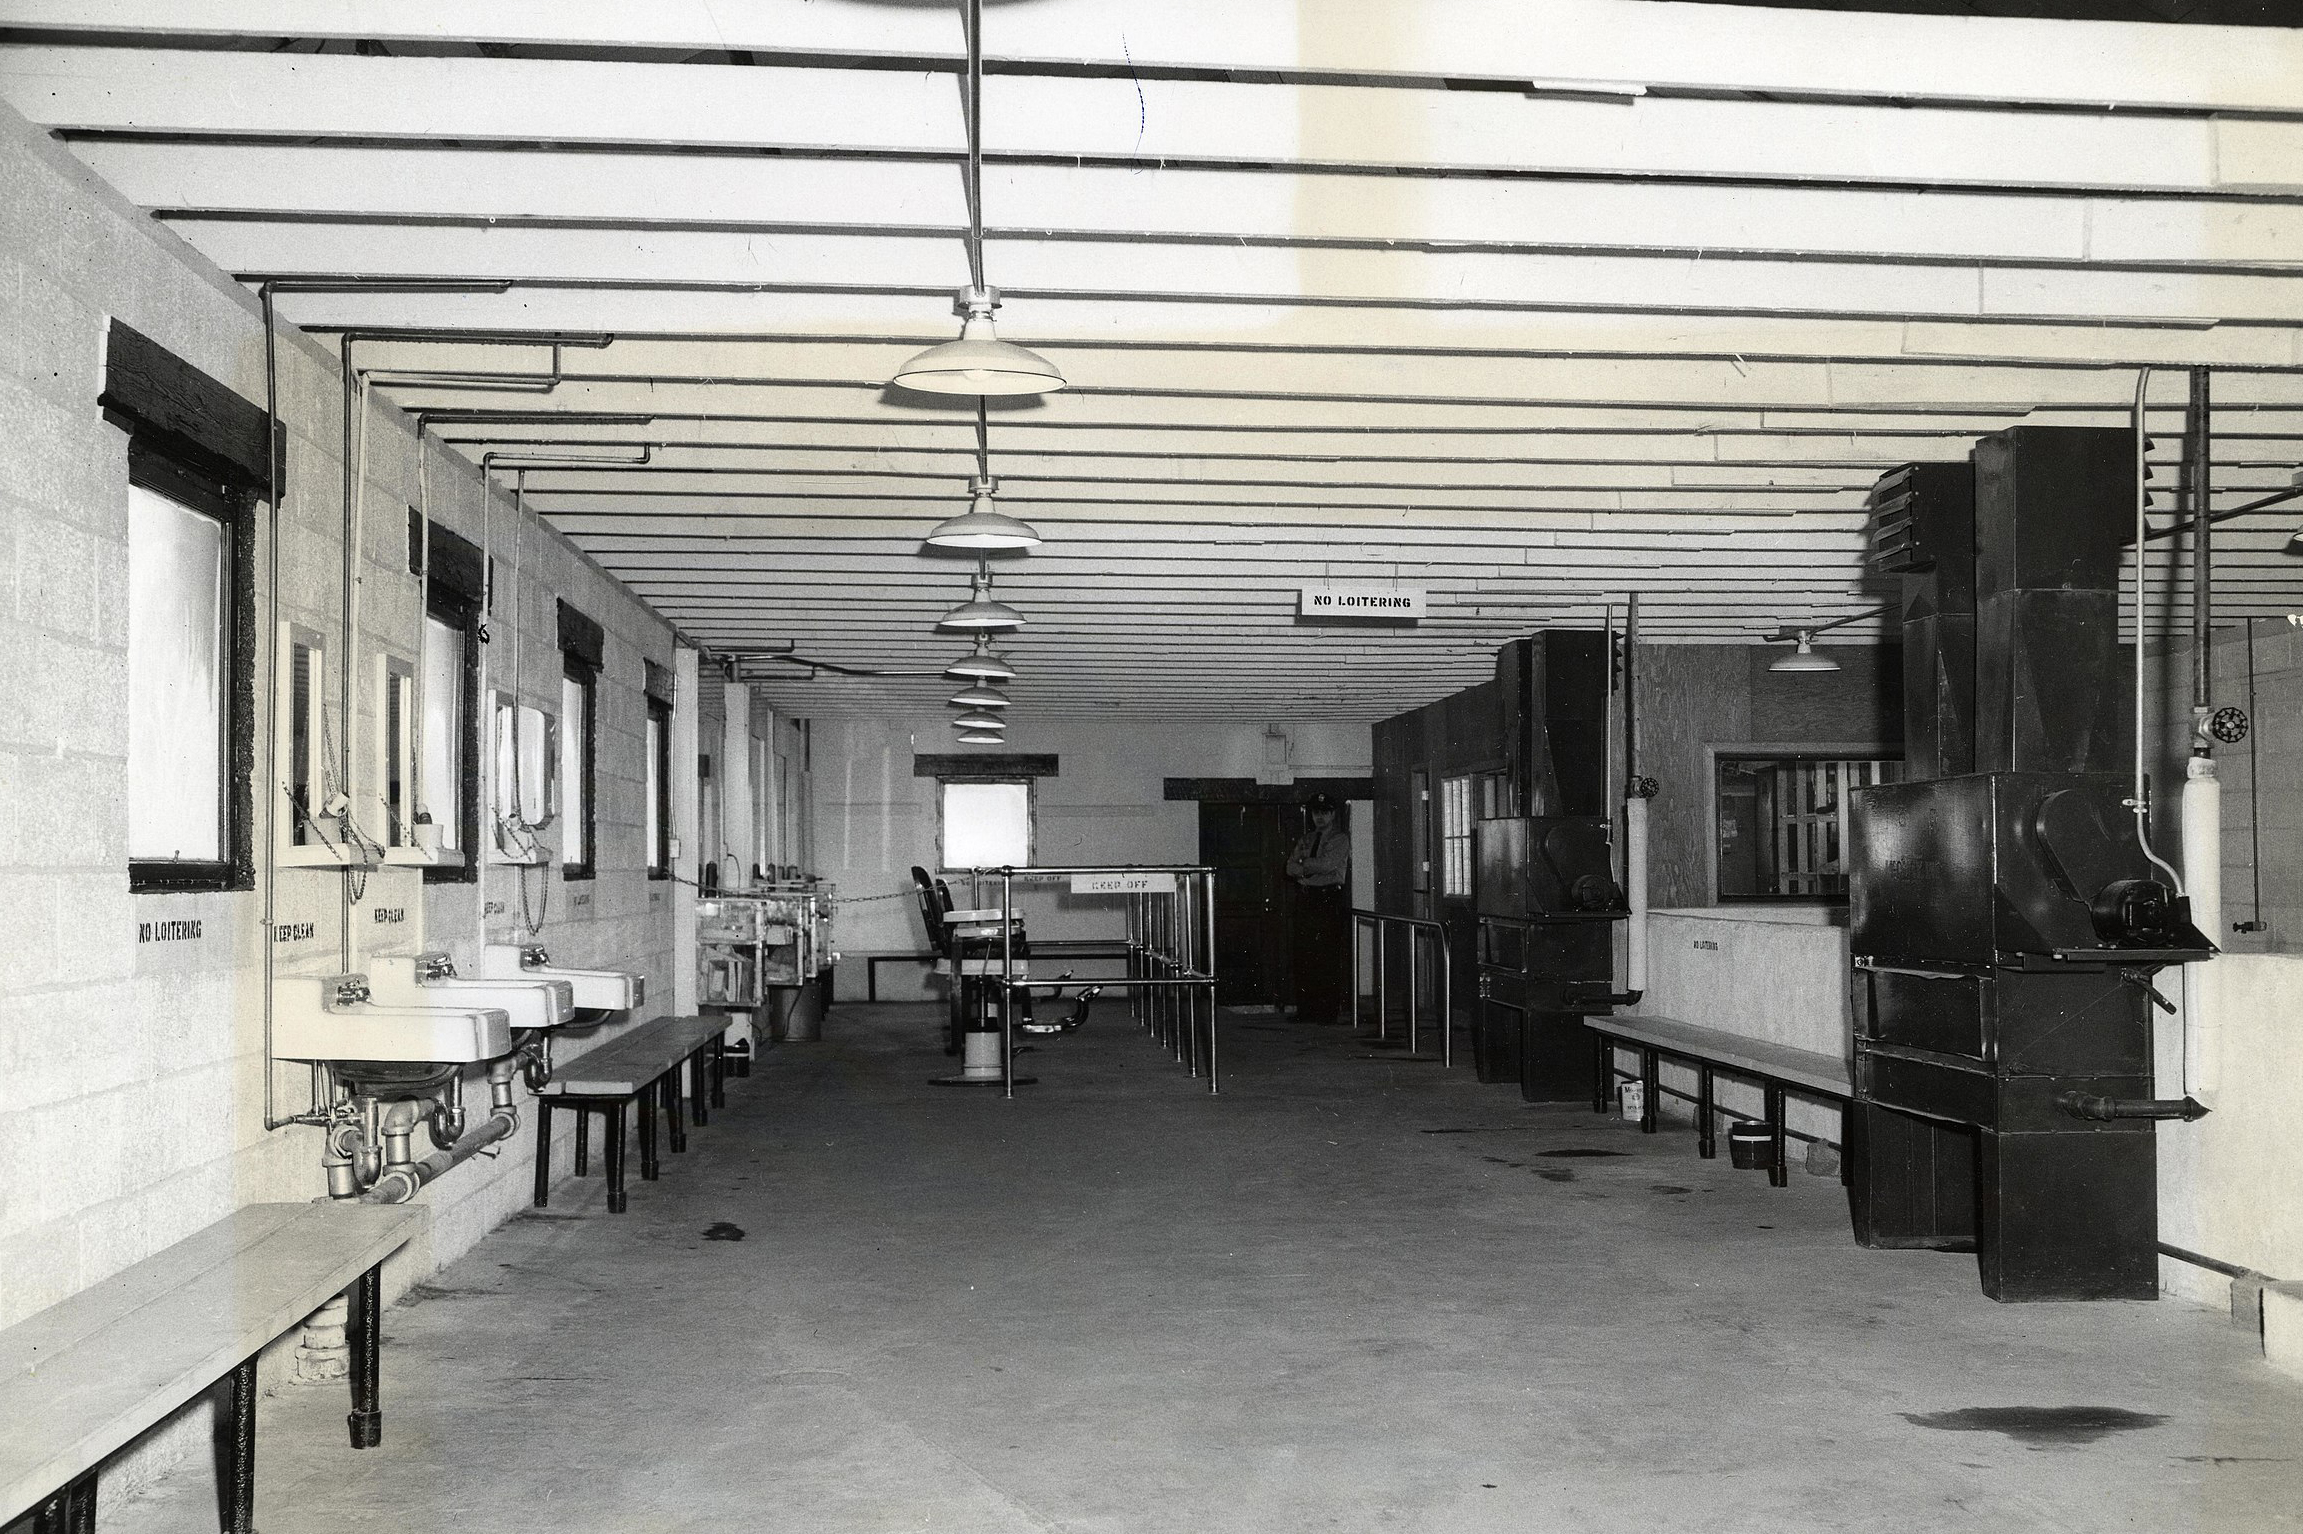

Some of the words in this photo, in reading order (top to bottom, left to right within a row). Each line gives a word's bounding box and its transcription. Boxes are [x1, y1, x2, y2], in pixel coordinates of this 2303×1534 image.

[1314, 595, 1332, 606] NO
[1338, 596, 1411, 608] LOITERING
[1092, 881, 1121, 890] KEEP
[1126, 880, 1148, 889] OFF
[139, 923, 151, 943] NO
[155, 920, 202, 941] LOITERING
[273, 925, 292, 943] KEEP
[293, 922, 314, 941] CLEAN
